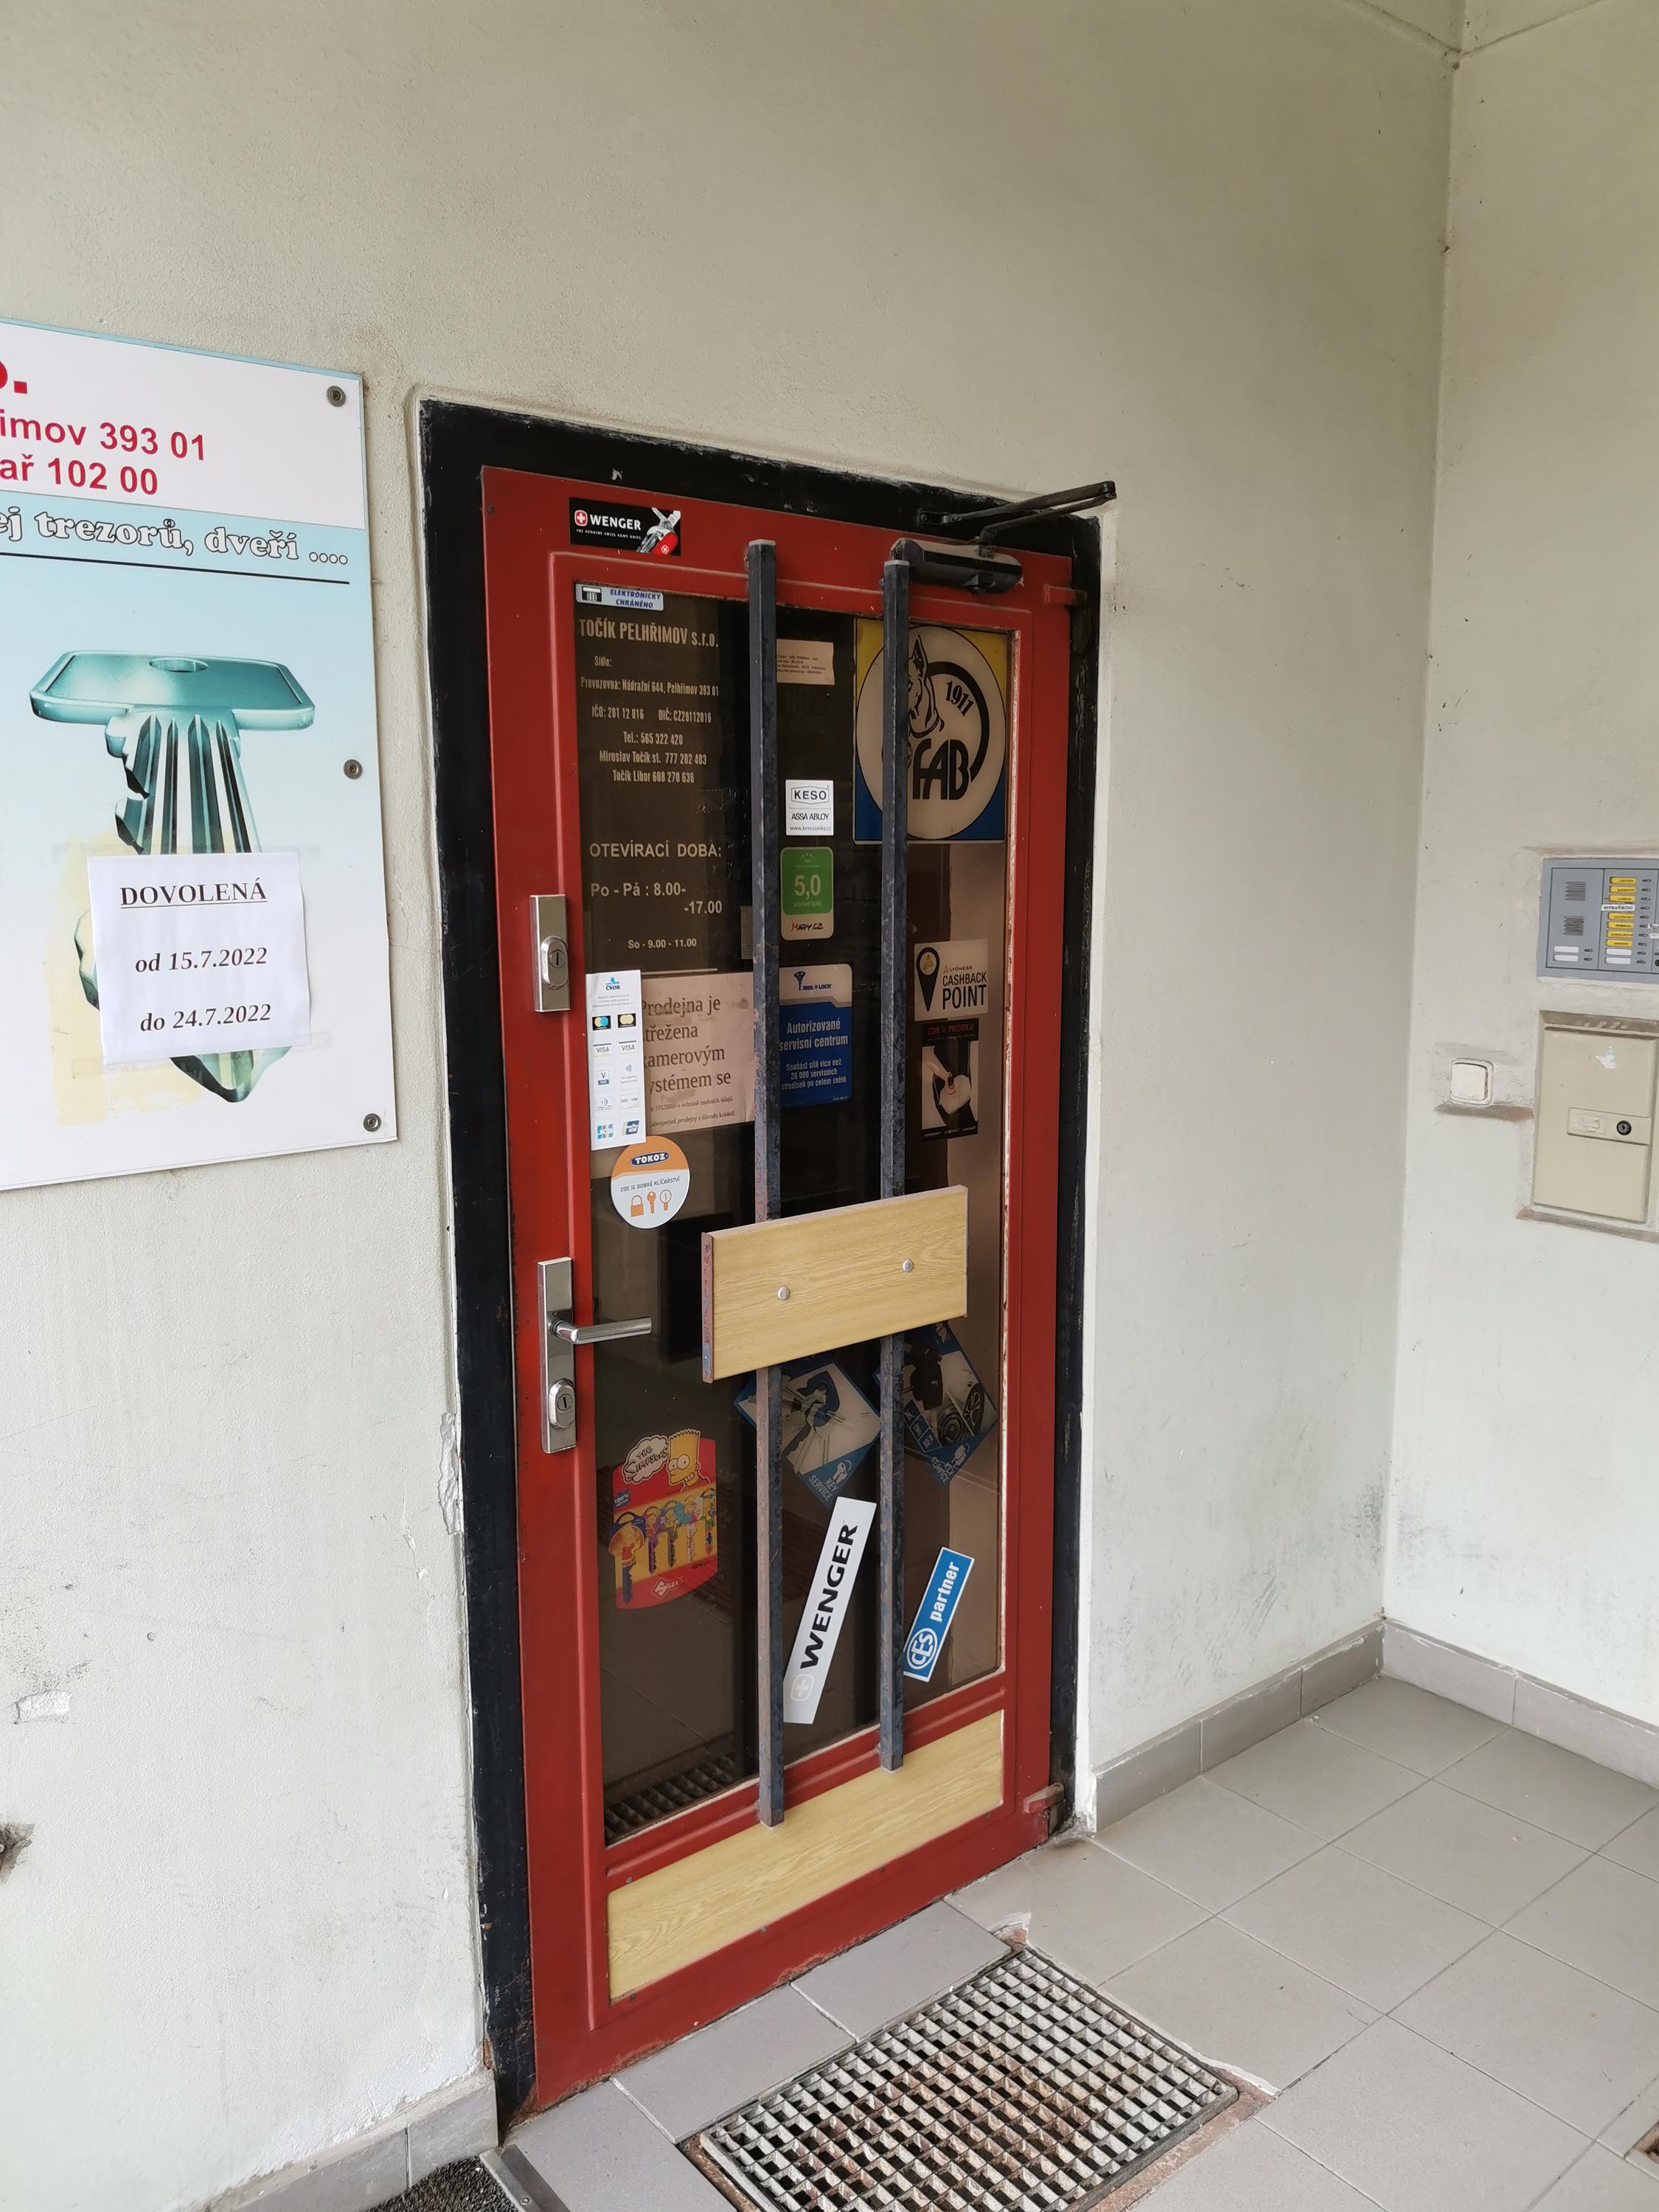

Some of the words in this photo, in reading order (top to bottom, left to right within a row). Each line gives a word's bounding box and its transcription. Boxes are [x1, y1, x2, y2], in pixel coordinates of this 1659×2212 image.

[100, 421, 159, 455] 393
[170, 431, 205, 461] 01
[48, 458, 108, 490] 102
[120, 465, 159, 495] 00
[590, 514, 641, 531] WENGER
[34, 511, 194, 556] trezorů,
[204, 526, 299, 560] dveří
[610, 589, 661, 600] ELEKTRONICKY
[579, 616, 616, 639] TOČÍK
[619, 621, 687, 644] PELHŘIMOV
[691, 631, 719, 647] s.r.o.
[594, 655, 612, 667] Sídlo:
[580, 676, 621, 691] Provozovna:
[622, 678, 650, 692] Nádražní
[667, 681, 698, 695] Pelhřimov
[699, 685, 710, 696] 393
[712, 686, 719, 697] 01
[945, 681, 974, 717] 1911
[591, 703, 606, 717] IČO:
[622, 708, 630, 719] 12
[658, 707, 672, 721] DIČ:
[623, 731, 639, 743] Tel.:
[641, 732, 653, 744] 565
[655, 733, 668, 745] 322
[670, 734, 684, 745] 420
[599, 750, 630, 762] Miroslav
[632, 751, 650, 763] Točík
[665, 753, 678, 764] 777
[680, 754, 692, 765] 202
[695, 754, 707, 765] 403
[613, 770, 631, 782] Točík
[633, 771, 650, 782] Libor
[667, 771, 680, 783] 270
[912, 739, 970, 800] FAB
[794, 790, 827, 800] KESO
[589, 840, 669, 858] OTEVÍRACÍ
[119, 877, 268, 907] DOVOLENÁ
[591, 883, 610, 897] Po
[623, 882, 640, 897] Pá
[794, 874, 821, 900] 5,0
[627, 939, 640, 948] So
[647, 939, 666, 948] 9.00
[675, 939, 697, 947] 11.00
[135, 953, 161, 973] od
[168, 946, 268, 972] 15.7.2022
[942, 972, 987, 987] CASHBACK
[707, 995, 720, 1015] je
[942, 984, 987, 1009] POINT
[140, 1012, 165, 1032] do
[173, 1004, 271, 1029] 24.7.2022
[787, 1018, 841, 1034] Autorizované
[645, 1024, 698, 1042] třežena
[779, 1036, 812, 1051] servisní
[814, 1035, 849, 1048] centrum
[785, 1062, 808, 1071] Součást
[650, 1074, 712, 1094] ystémem
[716, 1071, 731, 1085] se
[807, 1080, 814, 1089] po
[634, 1152, 666, 1164] TOKOZ
[636, 1180, 653, 1189] DOBRÉ
[654, 1175, 680, 1186] KLÍČAŘSTVÍ
[931, 1456, 950, 1484] SERVICE
[808, 1475, 833, 1502] SERVICE
[825, 1478, 839, 1492] KEY
[800, 1524, 858, 1669] WENGER
[930, 1561, 960, 1623] partner
